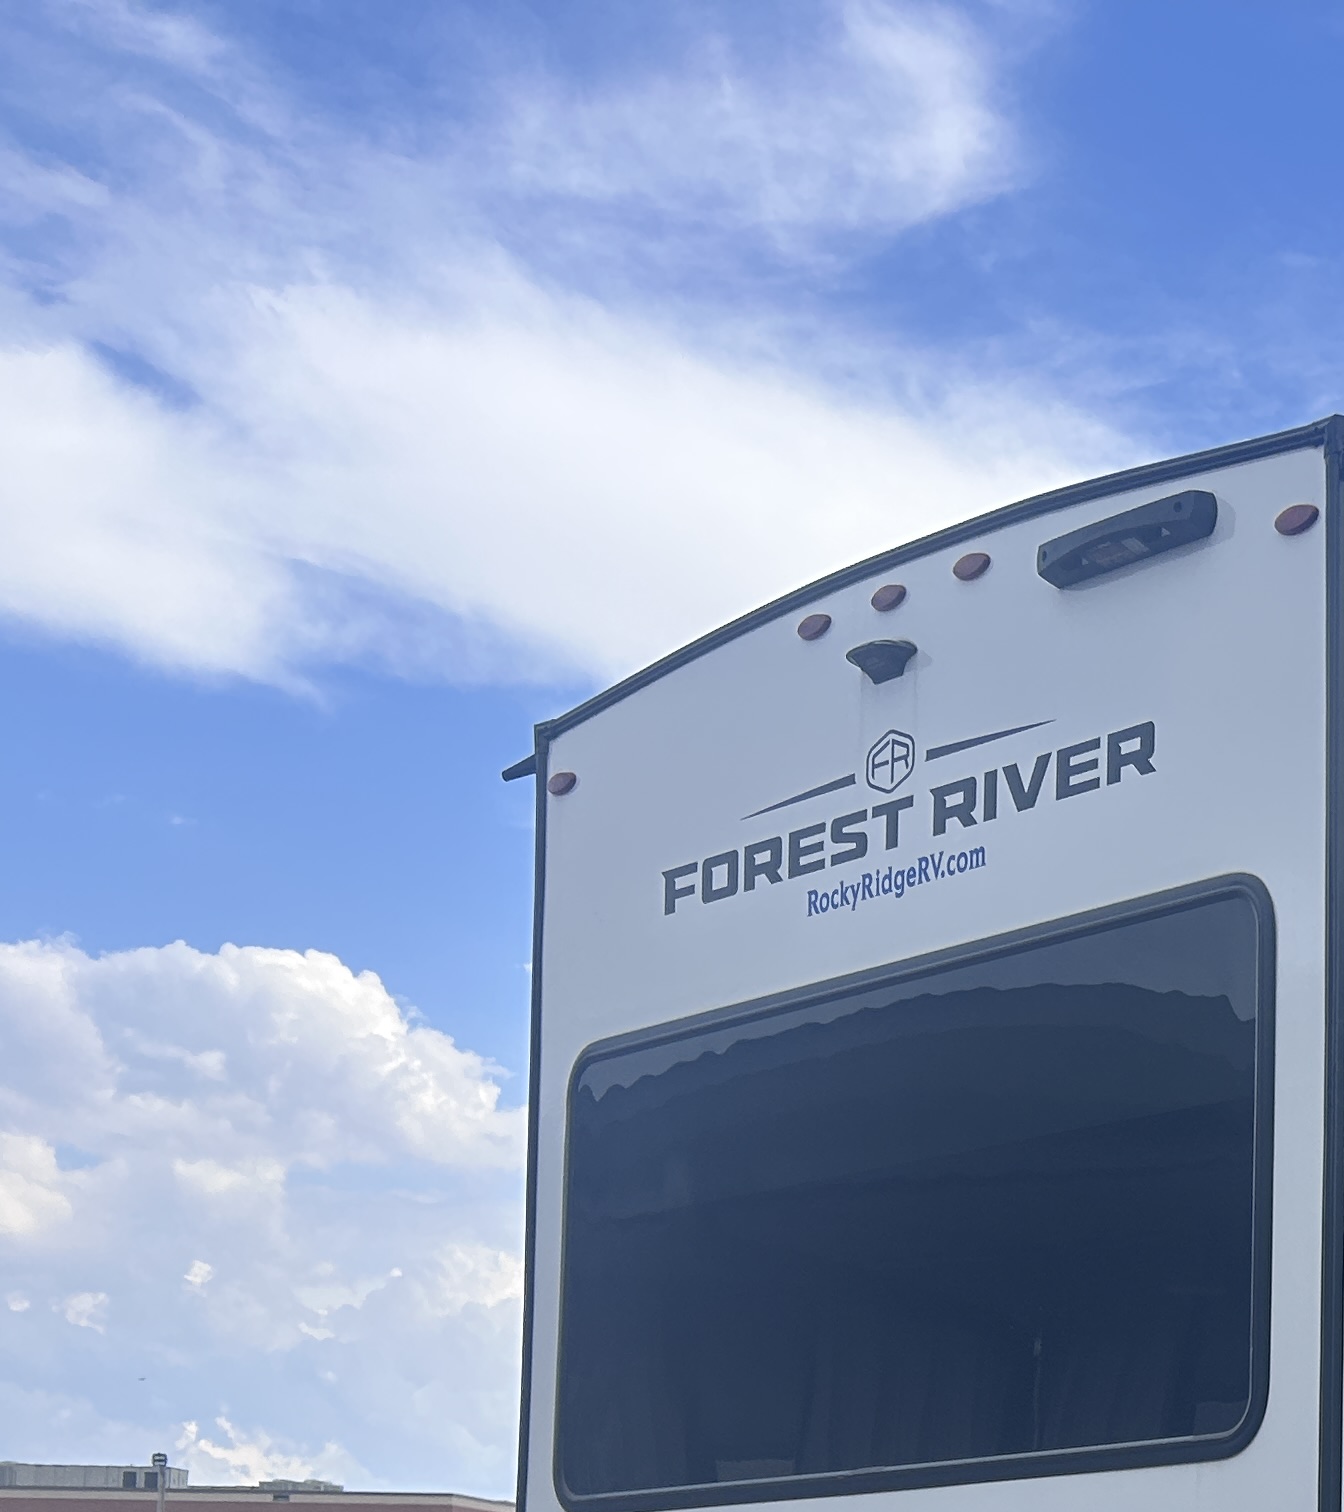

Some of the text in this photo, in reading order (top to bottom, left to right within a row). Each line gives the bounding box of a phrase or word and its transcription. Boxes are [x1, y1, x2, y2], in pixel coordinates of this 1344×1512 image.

[661, 720, 1156, 915] FOREST RIVER
[806, 845, 987, 917] RockyRidgeRV.com
